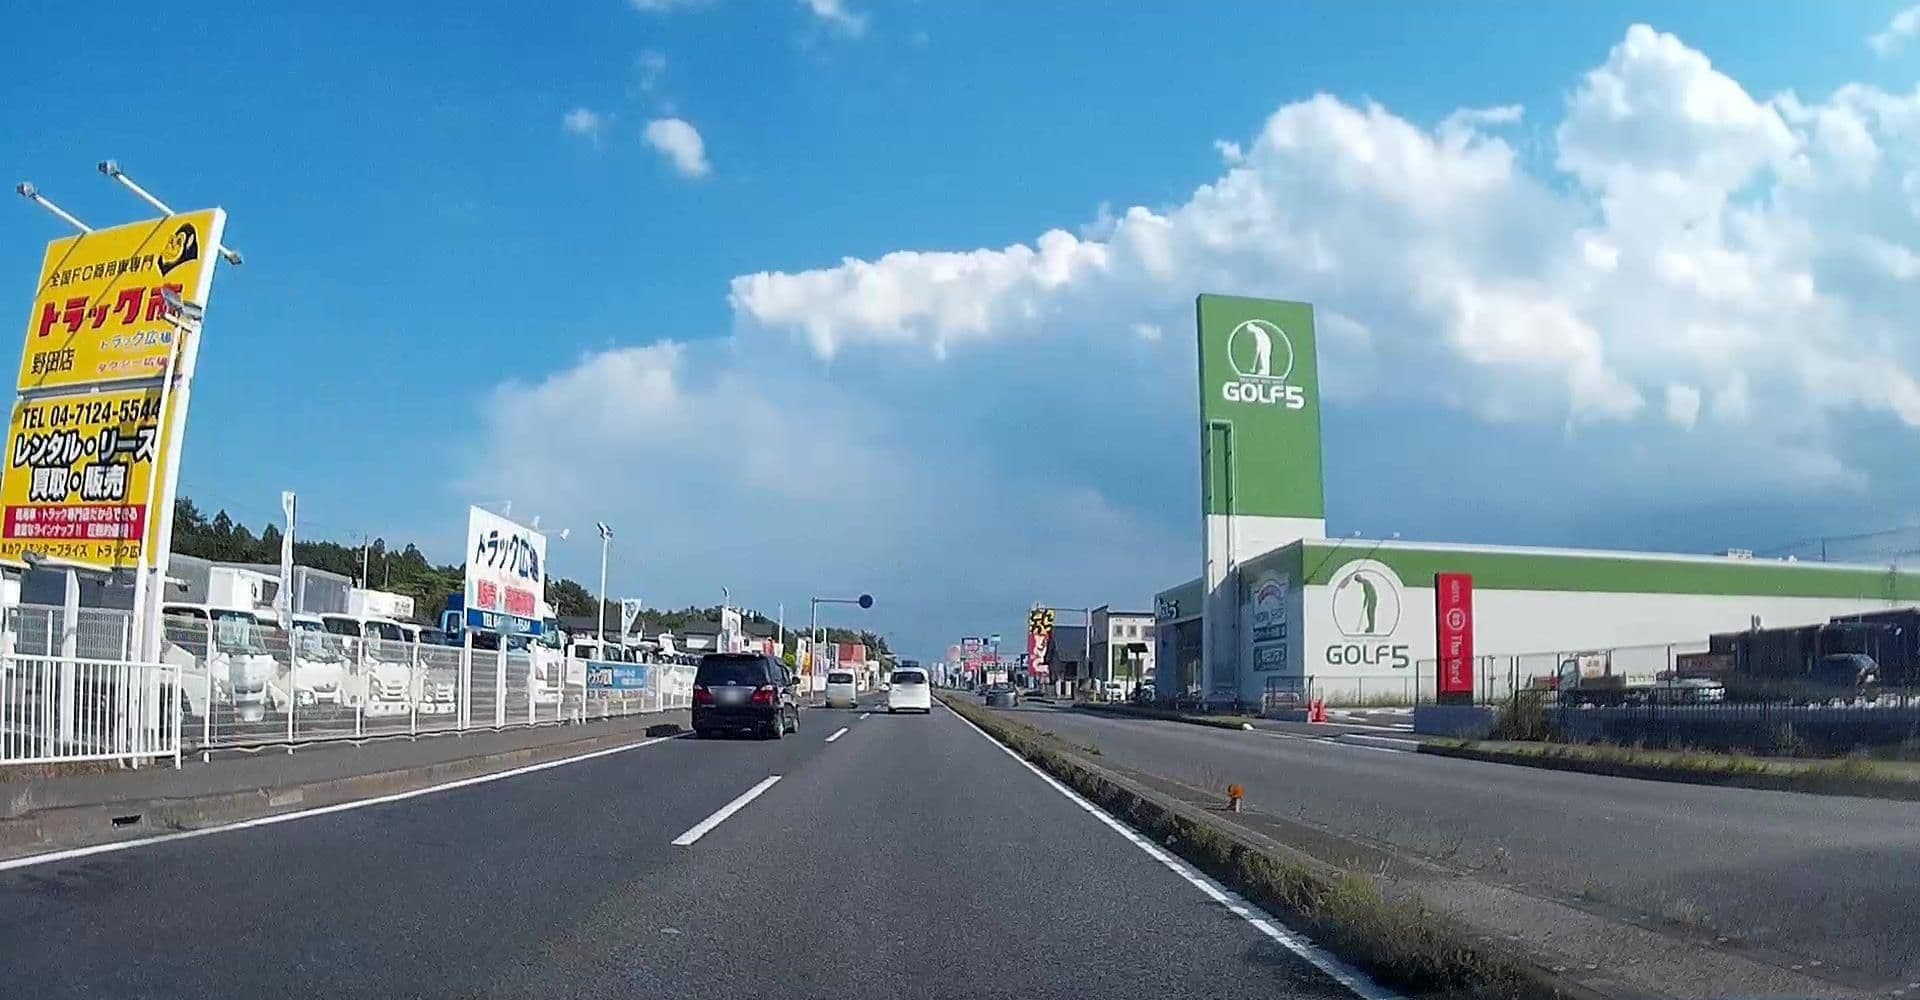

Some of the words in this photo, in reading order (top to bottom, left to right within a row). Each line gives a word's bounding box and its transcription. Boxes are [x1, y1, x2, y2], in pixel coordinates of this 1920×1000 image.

[31, 348, 75, 375] 野田店
[1222, 381, 1305, 409] GOLF5
[23, 408, 45, 429] TEL
[51, 397, 161, 428] 04-7124-5544
[13, 425, 157, 468] レンタル・リース
[29, 462, 130, 502] 買取・販売
[1326, 645, 1409, 669] GOLF5
